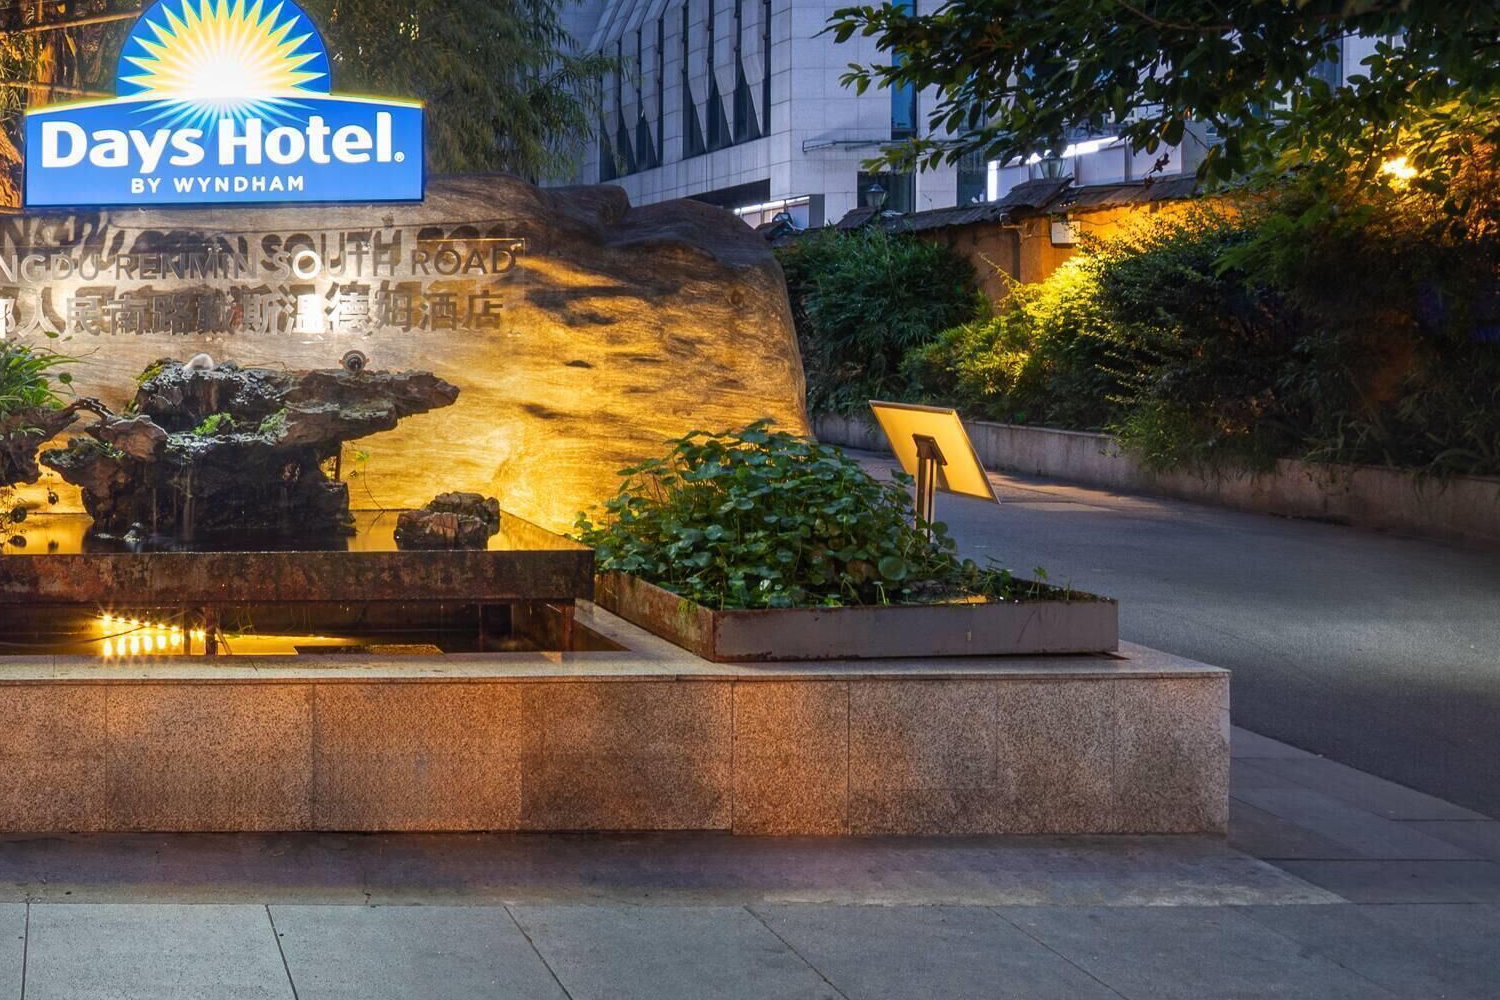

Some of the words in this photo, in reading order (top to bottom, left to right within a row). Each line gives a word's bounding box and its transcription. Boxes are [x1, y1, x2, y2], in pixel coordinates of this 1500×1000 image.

[41, 121, 206, 174] Days
[130, 178, 162, 194] BY
[173, 175, 305, 193] WYNDHAM
[115, 251, 258, 281] RENMIN
[271, 247, 398, 281] SOUTH
[411, 245, 517, 277] ROAD
